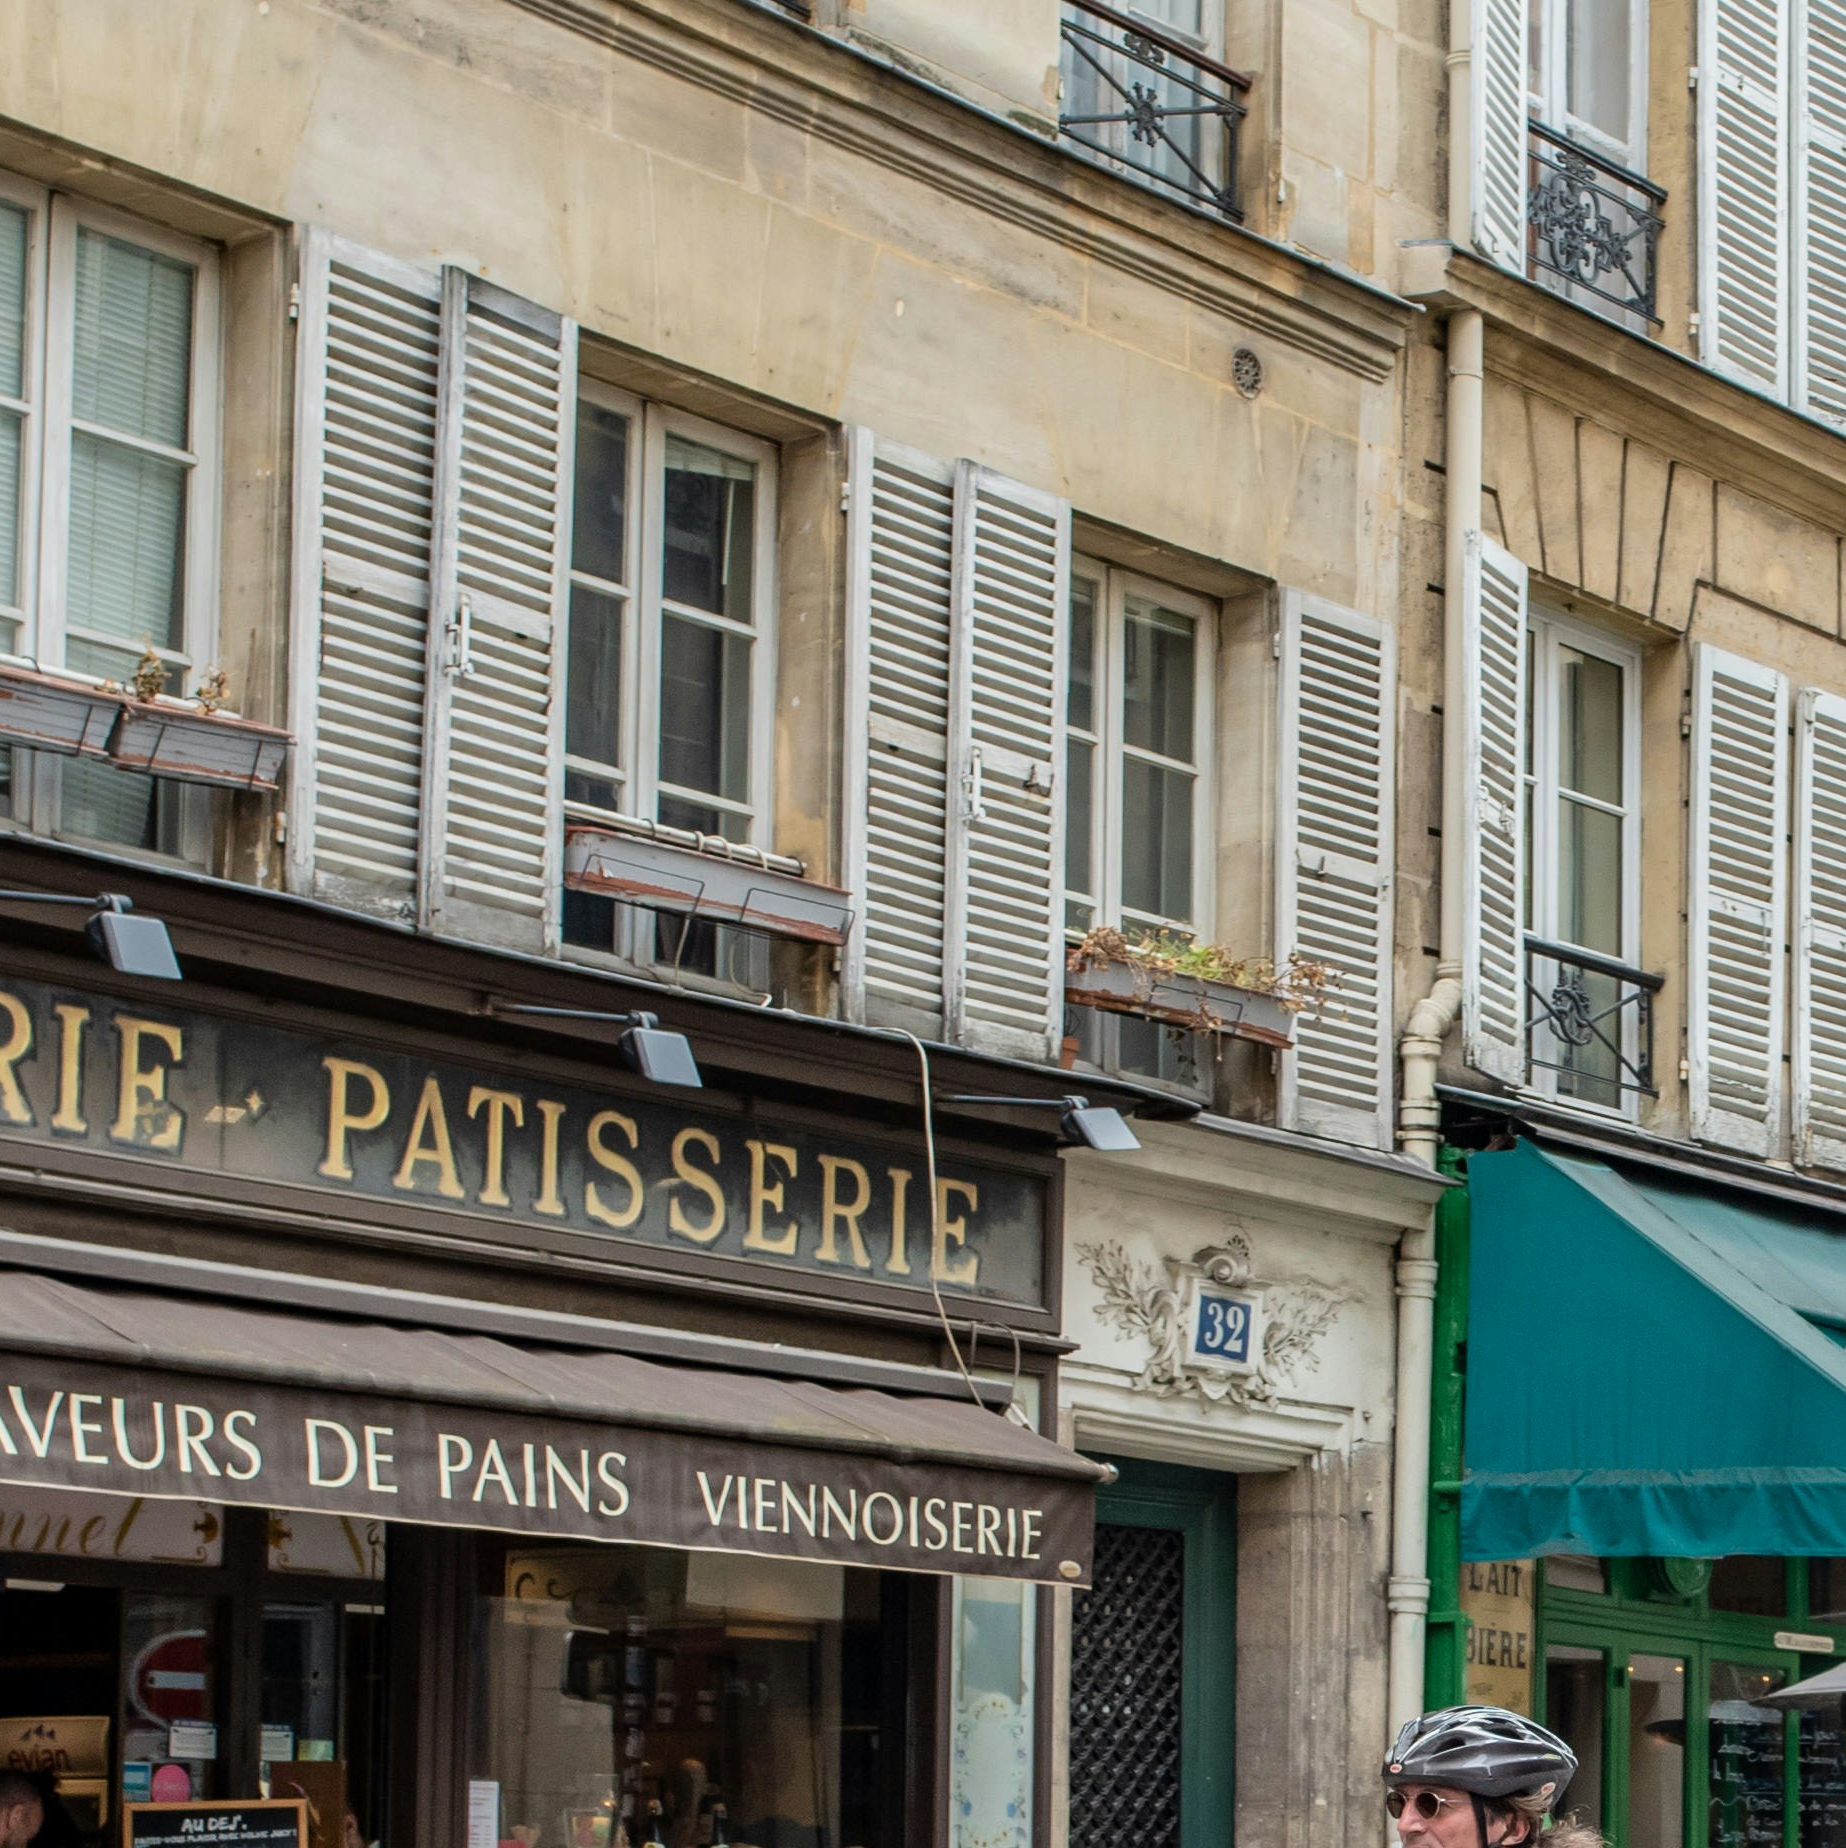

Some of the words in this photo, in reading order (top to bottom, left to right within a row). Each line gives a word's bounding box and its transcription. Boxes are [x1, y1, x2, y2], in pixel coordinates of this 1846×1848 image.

[318, 1055, 983, 1288] PATISSERIE
[1204, 1302, 1245, 1353] 32
[306, 1417, 400, 1495] DE
[437, 1432, 630, 1518] PAINS
[697, 1469, 1044, 1561] VIENNOISERIE
[7, 1743, 71, 1771] evian
[180, 1818, 204, 1834] AU
